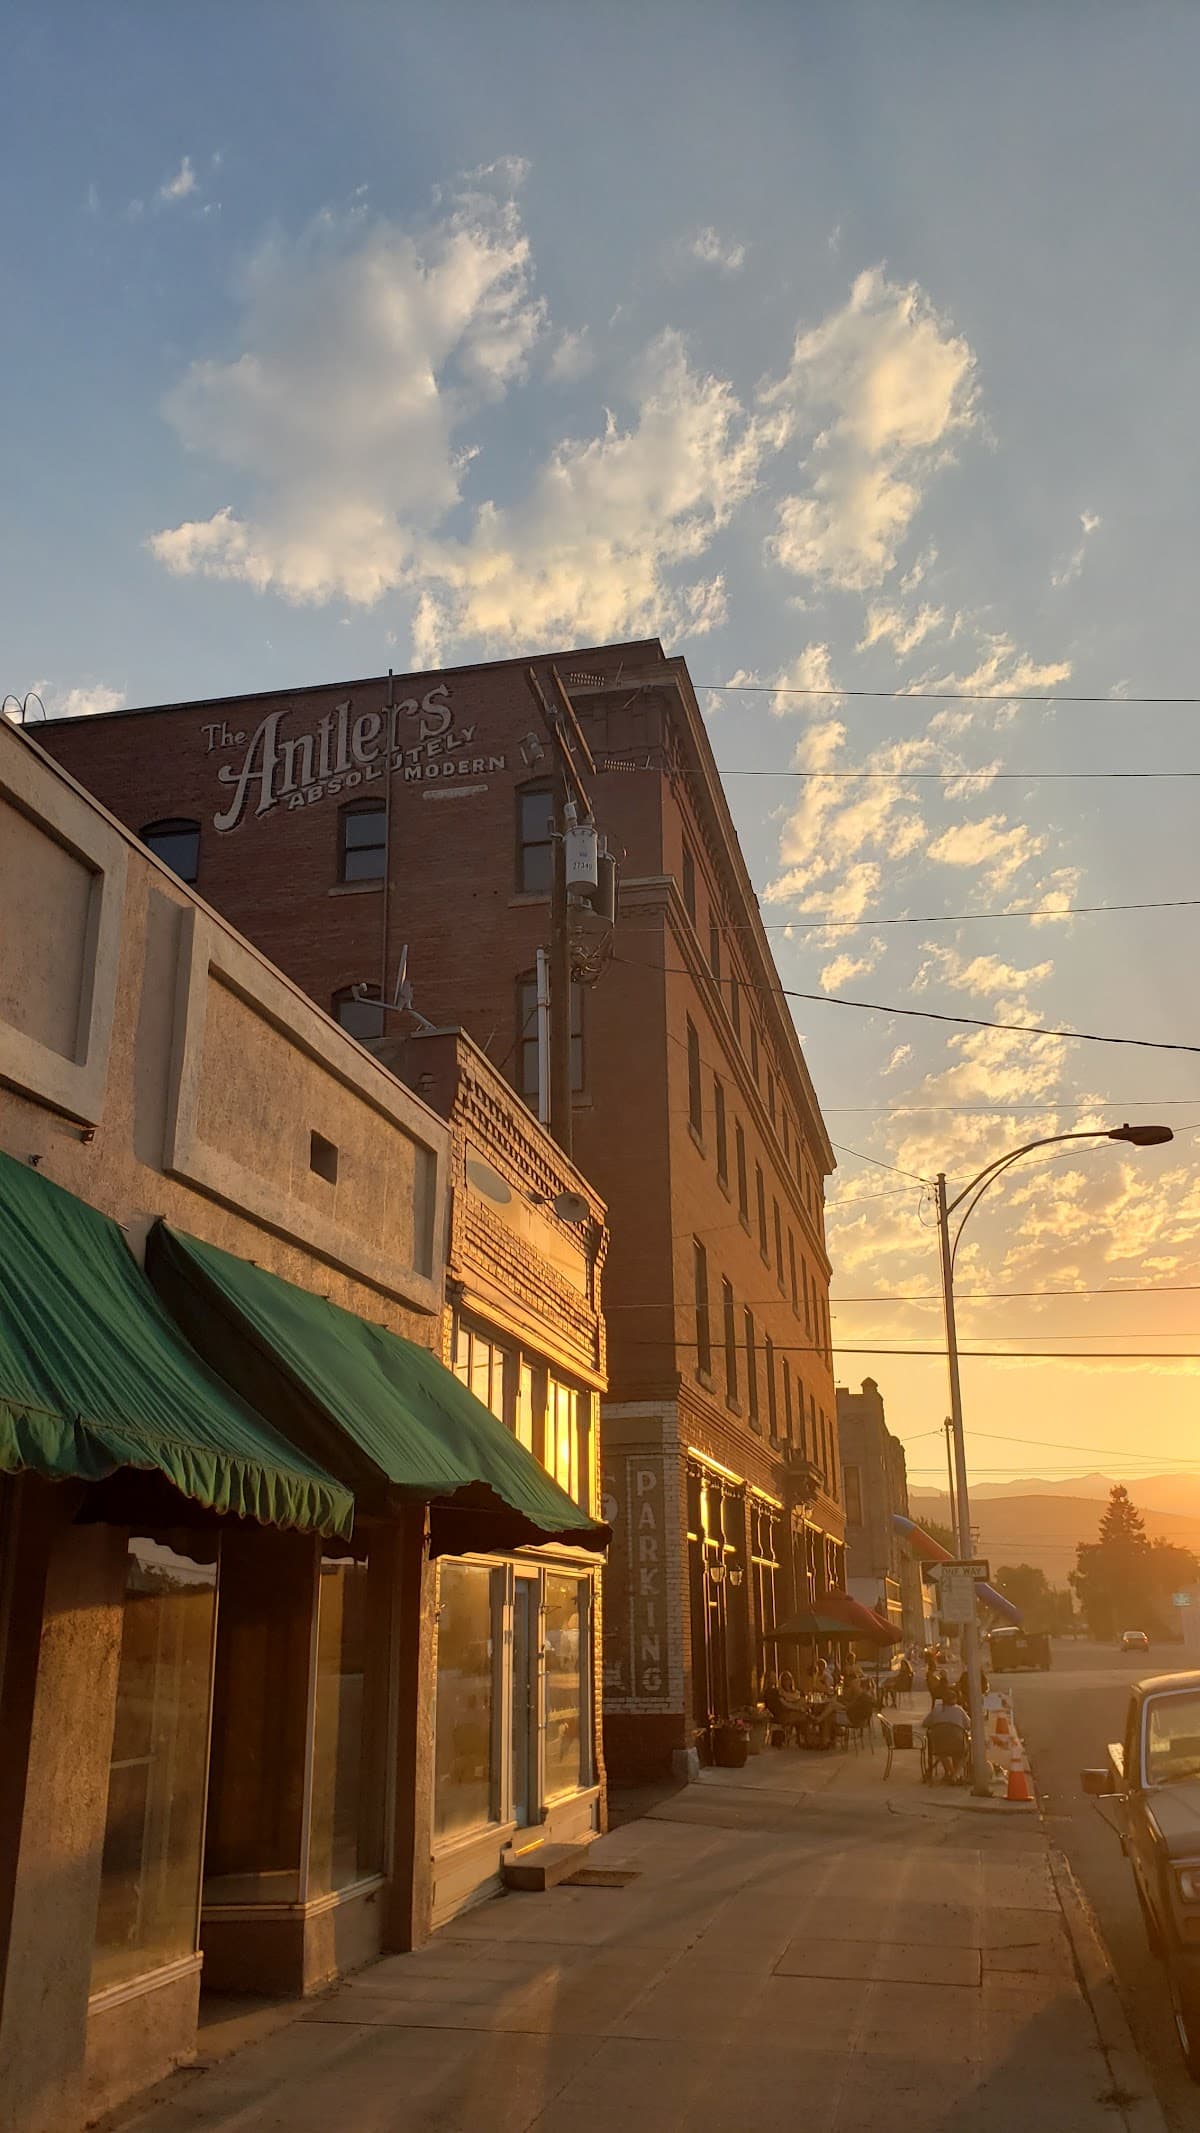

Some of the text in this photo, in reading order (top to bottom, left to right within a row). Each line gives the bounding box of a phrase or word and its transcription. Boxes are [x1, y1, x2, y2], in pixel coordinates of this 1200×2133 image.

[201, 684, 454, 833] The Antlers
[404, 756, 506, 782] MODERN
[636, 1470, 664, 1692] PARKING
[963, 1567, 982, 1576] WAY
